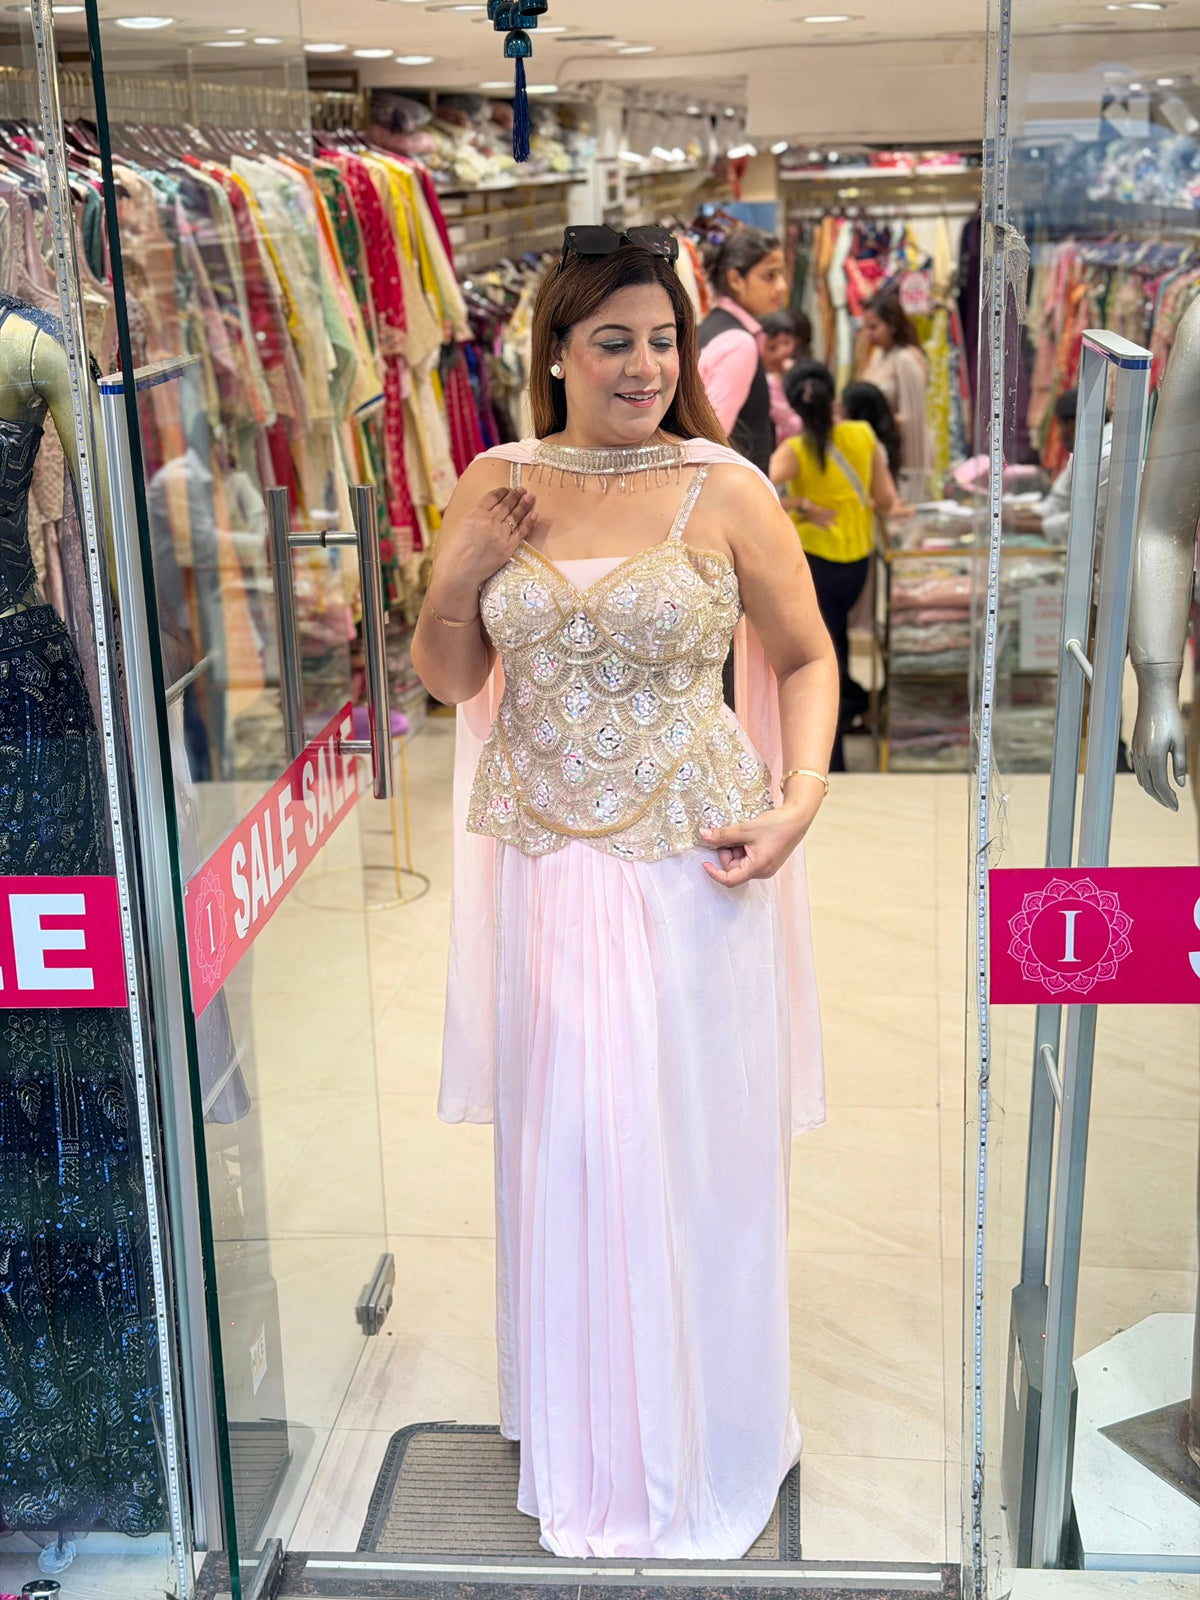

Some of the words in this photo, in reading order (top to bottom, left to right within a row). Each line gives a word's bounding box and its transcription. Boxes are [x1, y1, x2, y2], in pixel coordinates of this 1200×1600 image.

[206, 902, 215, 955] I
[231, 783, 297, 939] SALE
[302, 715, 355, 847] SALE
[0, 893, 94, 990] E
[1058, 911, 1082, 962] I
